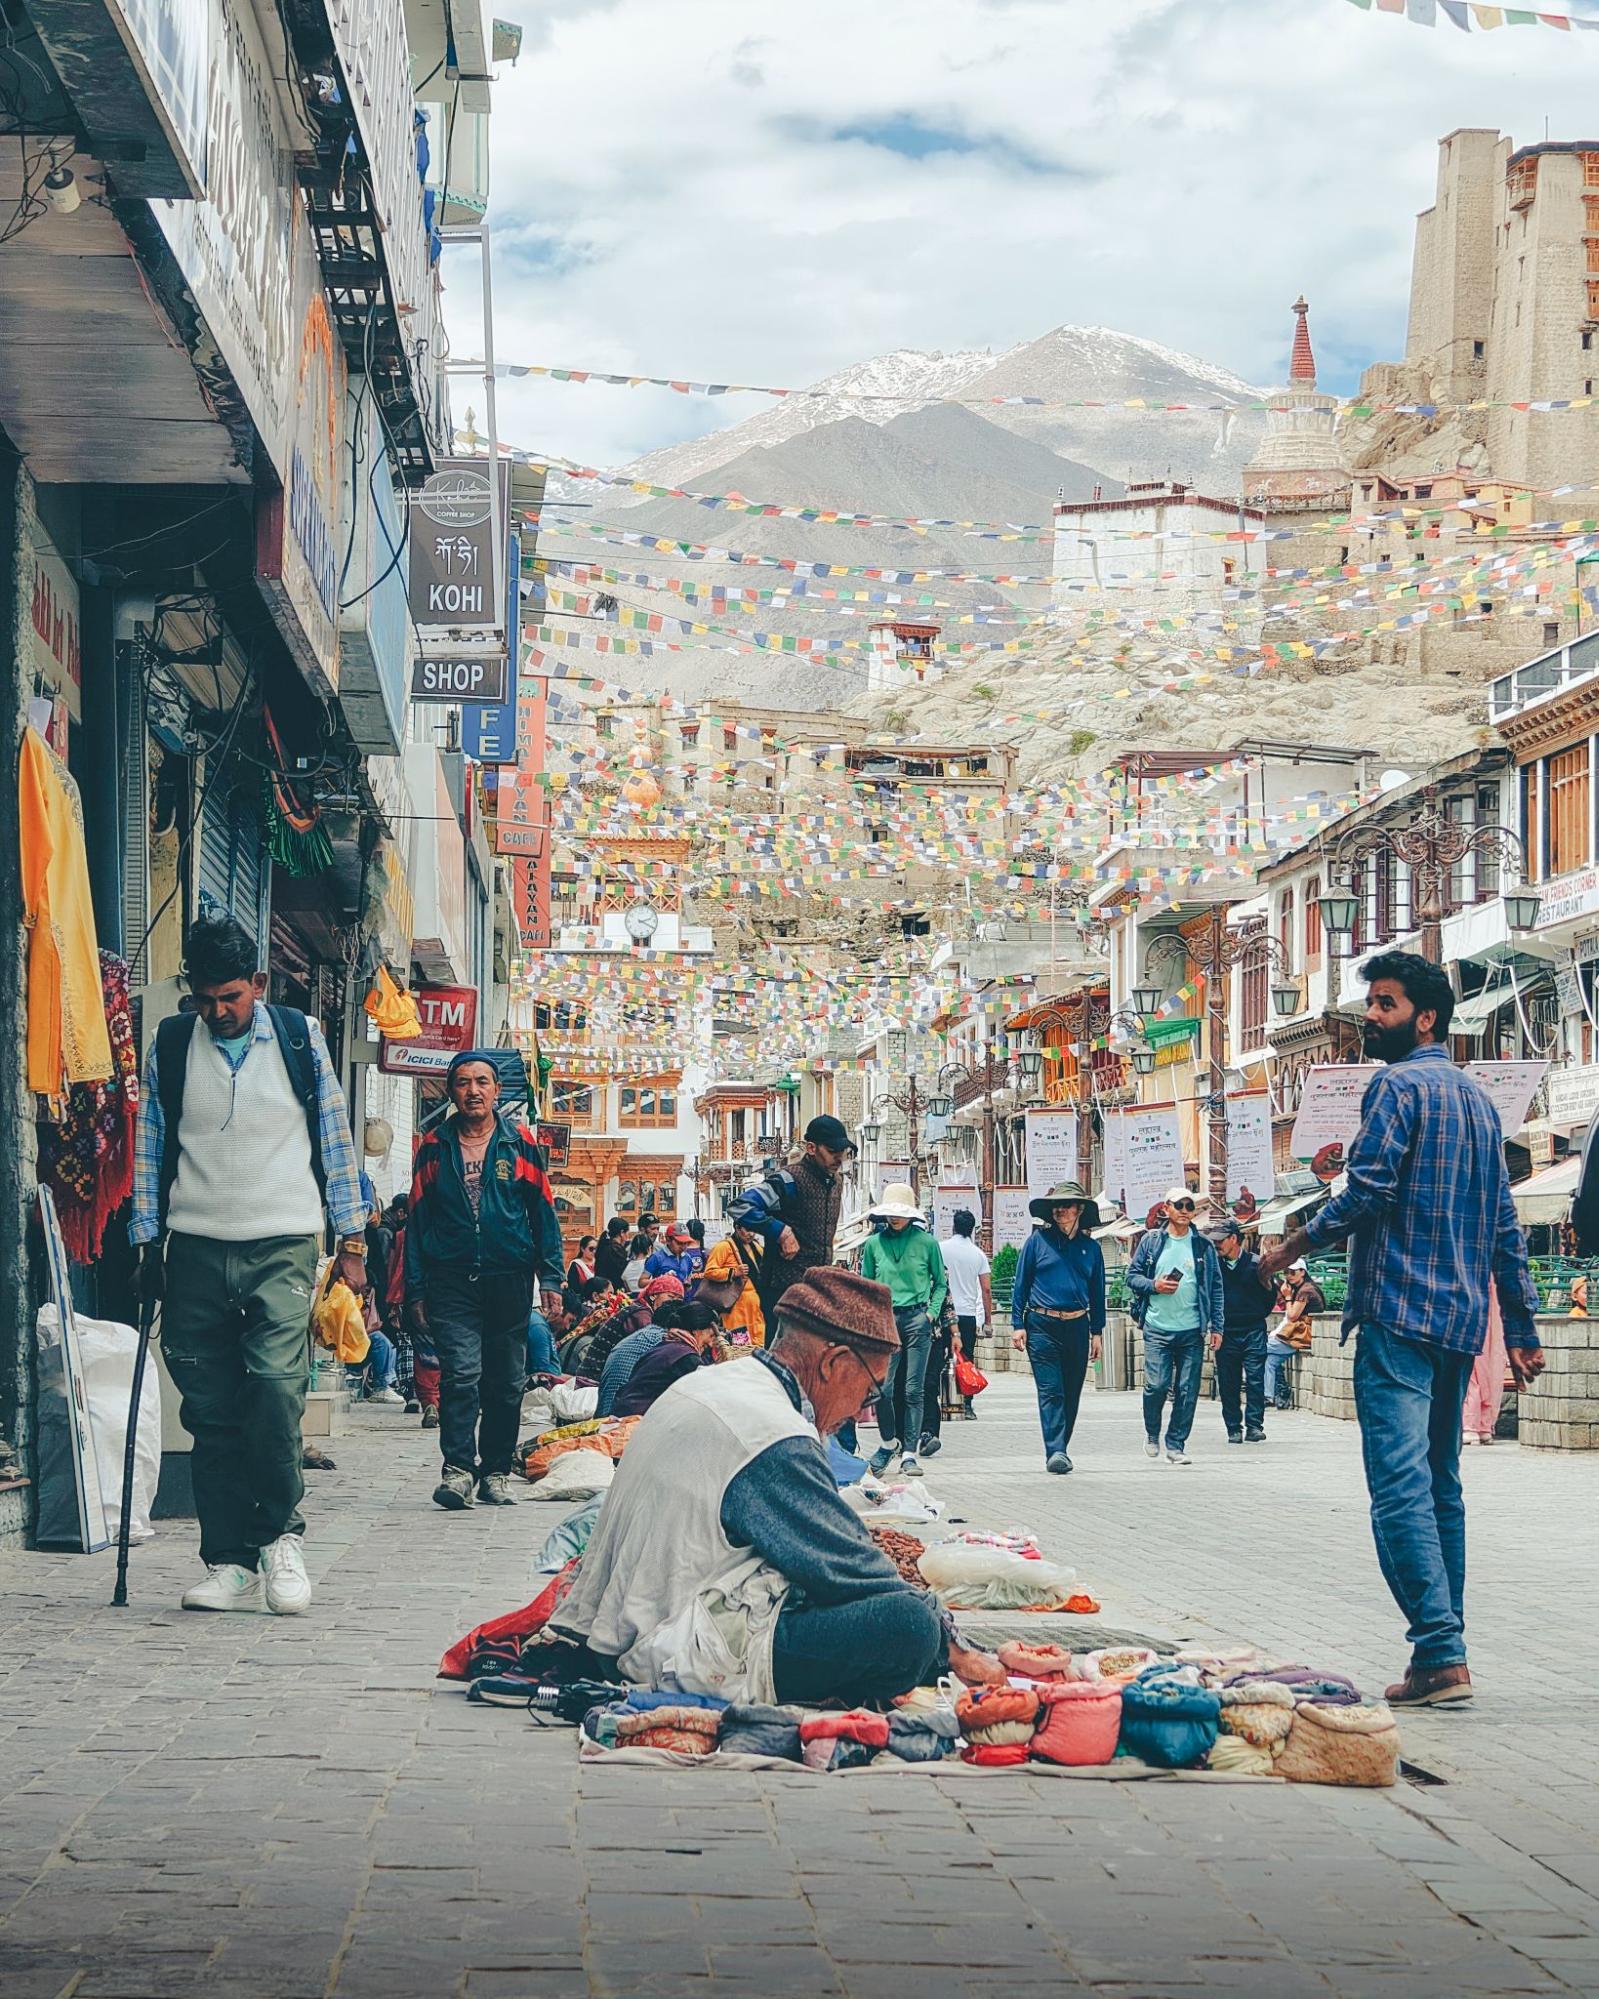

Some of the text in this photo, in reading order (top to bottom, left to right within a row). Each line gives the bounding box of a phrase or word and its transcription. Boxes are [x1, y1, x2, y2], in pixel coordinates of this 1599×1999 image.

[429, 584, 482, 612] KOHI
[423, 662, 484, 691] SHOP
[1537, 895, 1584, 925] RESTAURANT
[408, 1055, 433, 1065] ICICI
